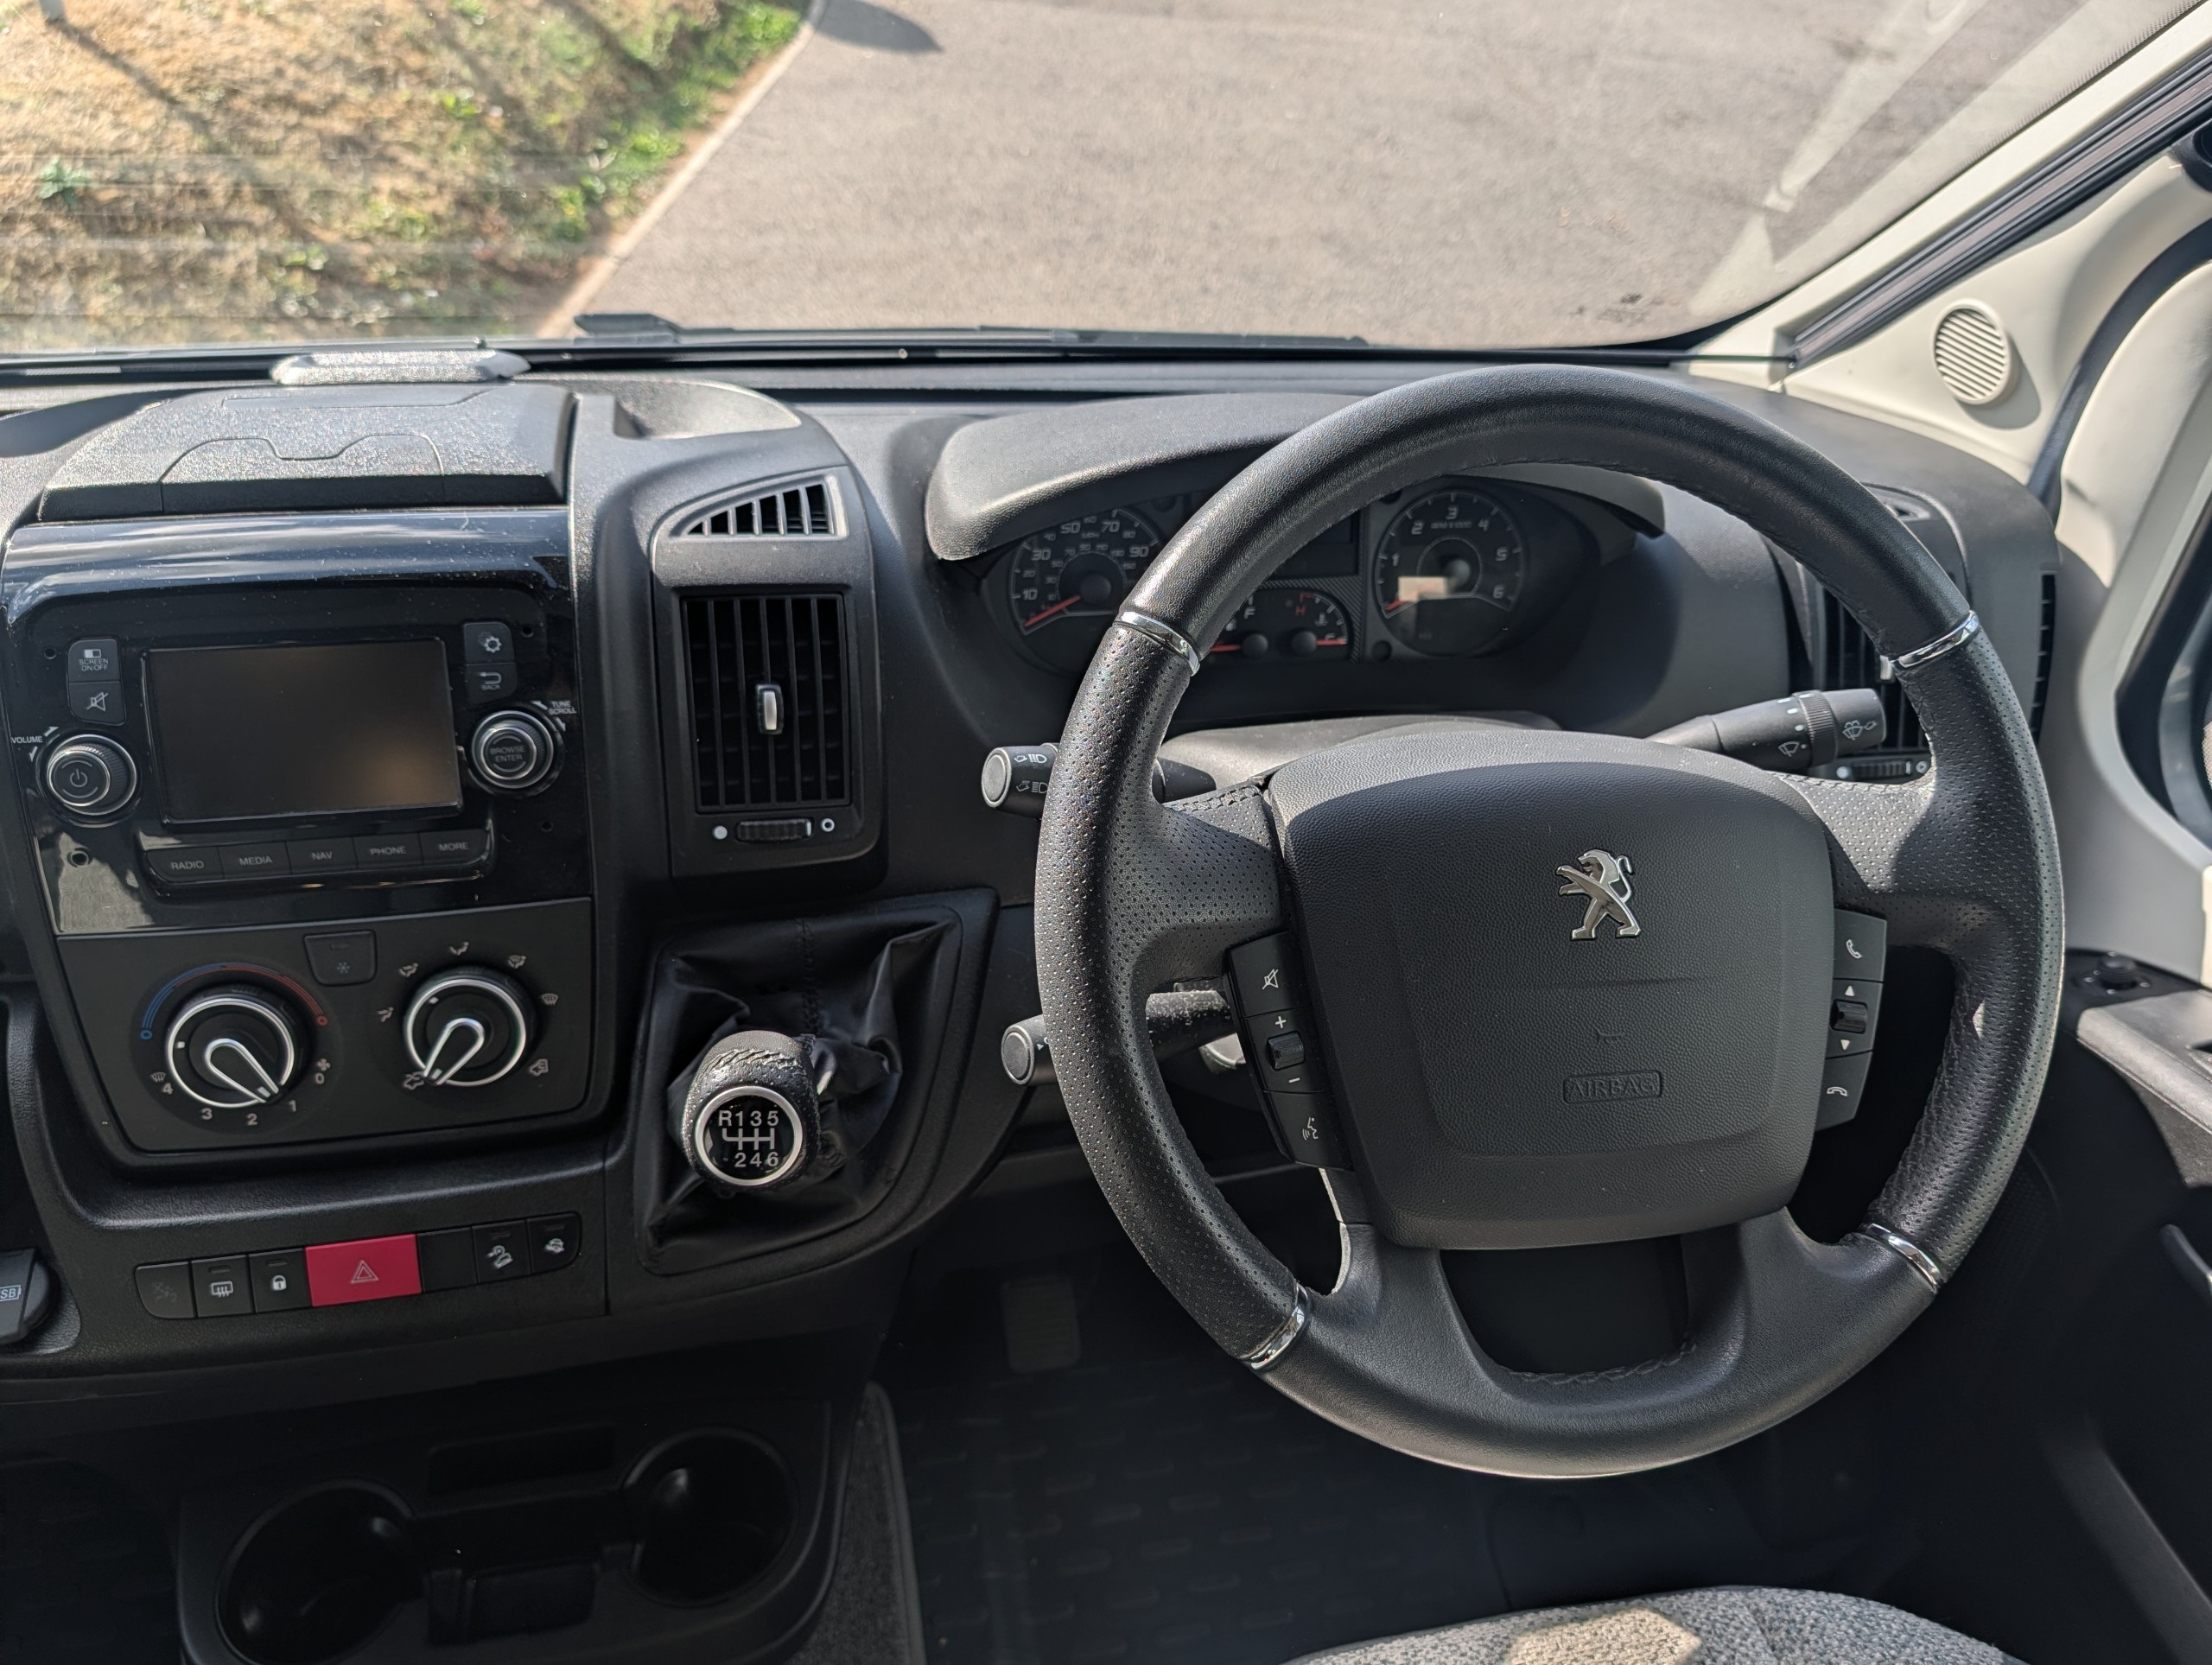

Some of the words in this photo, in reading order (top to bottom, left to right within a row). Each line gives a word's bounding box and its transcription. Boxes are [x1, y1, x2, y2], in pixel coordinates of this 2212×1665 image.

[1446, 505, 1459, 519] 3
[1060, 522, 1081, 534] 50
[1101, 520, 1121, 533] 70
[1411, 521, 1424, 535] 2
[1478, 518, 1490, 531] 4
[1032, 549, 1051, 561] 30
[1129, 545, 1149, 558] 90
[1496, 546, 1508, 561] 5
[1391, 552, 1400, 566] 1
[1023, 588, 1038, 601] 10
[1493, 584, 1504, 598] 6
[548, 707, 577, 715] SCROLL
[10, 735, 43, 745] VOLUME
[490, 746, 526, 755] BROWSE
[495, 754, 523, 763] ENTER
[370, 845, 408, 856] PHONE
[438, 842, 470, 852] MORE
[238, 855, 273, 867] MEDIA
[311, 851, 334, 861] NAV
[171, 860, 205, 871] RADIO
[162, 1082, 174, 1096] 4
[1569, 1075, 1656, 1097] AIRBAG
[288, 1099, 297, 1113] 1
[200, 1107, 213, 1121] 3
[246, 1113, 258, 1126] 2
[0, 1287, 16, 1300] SB
